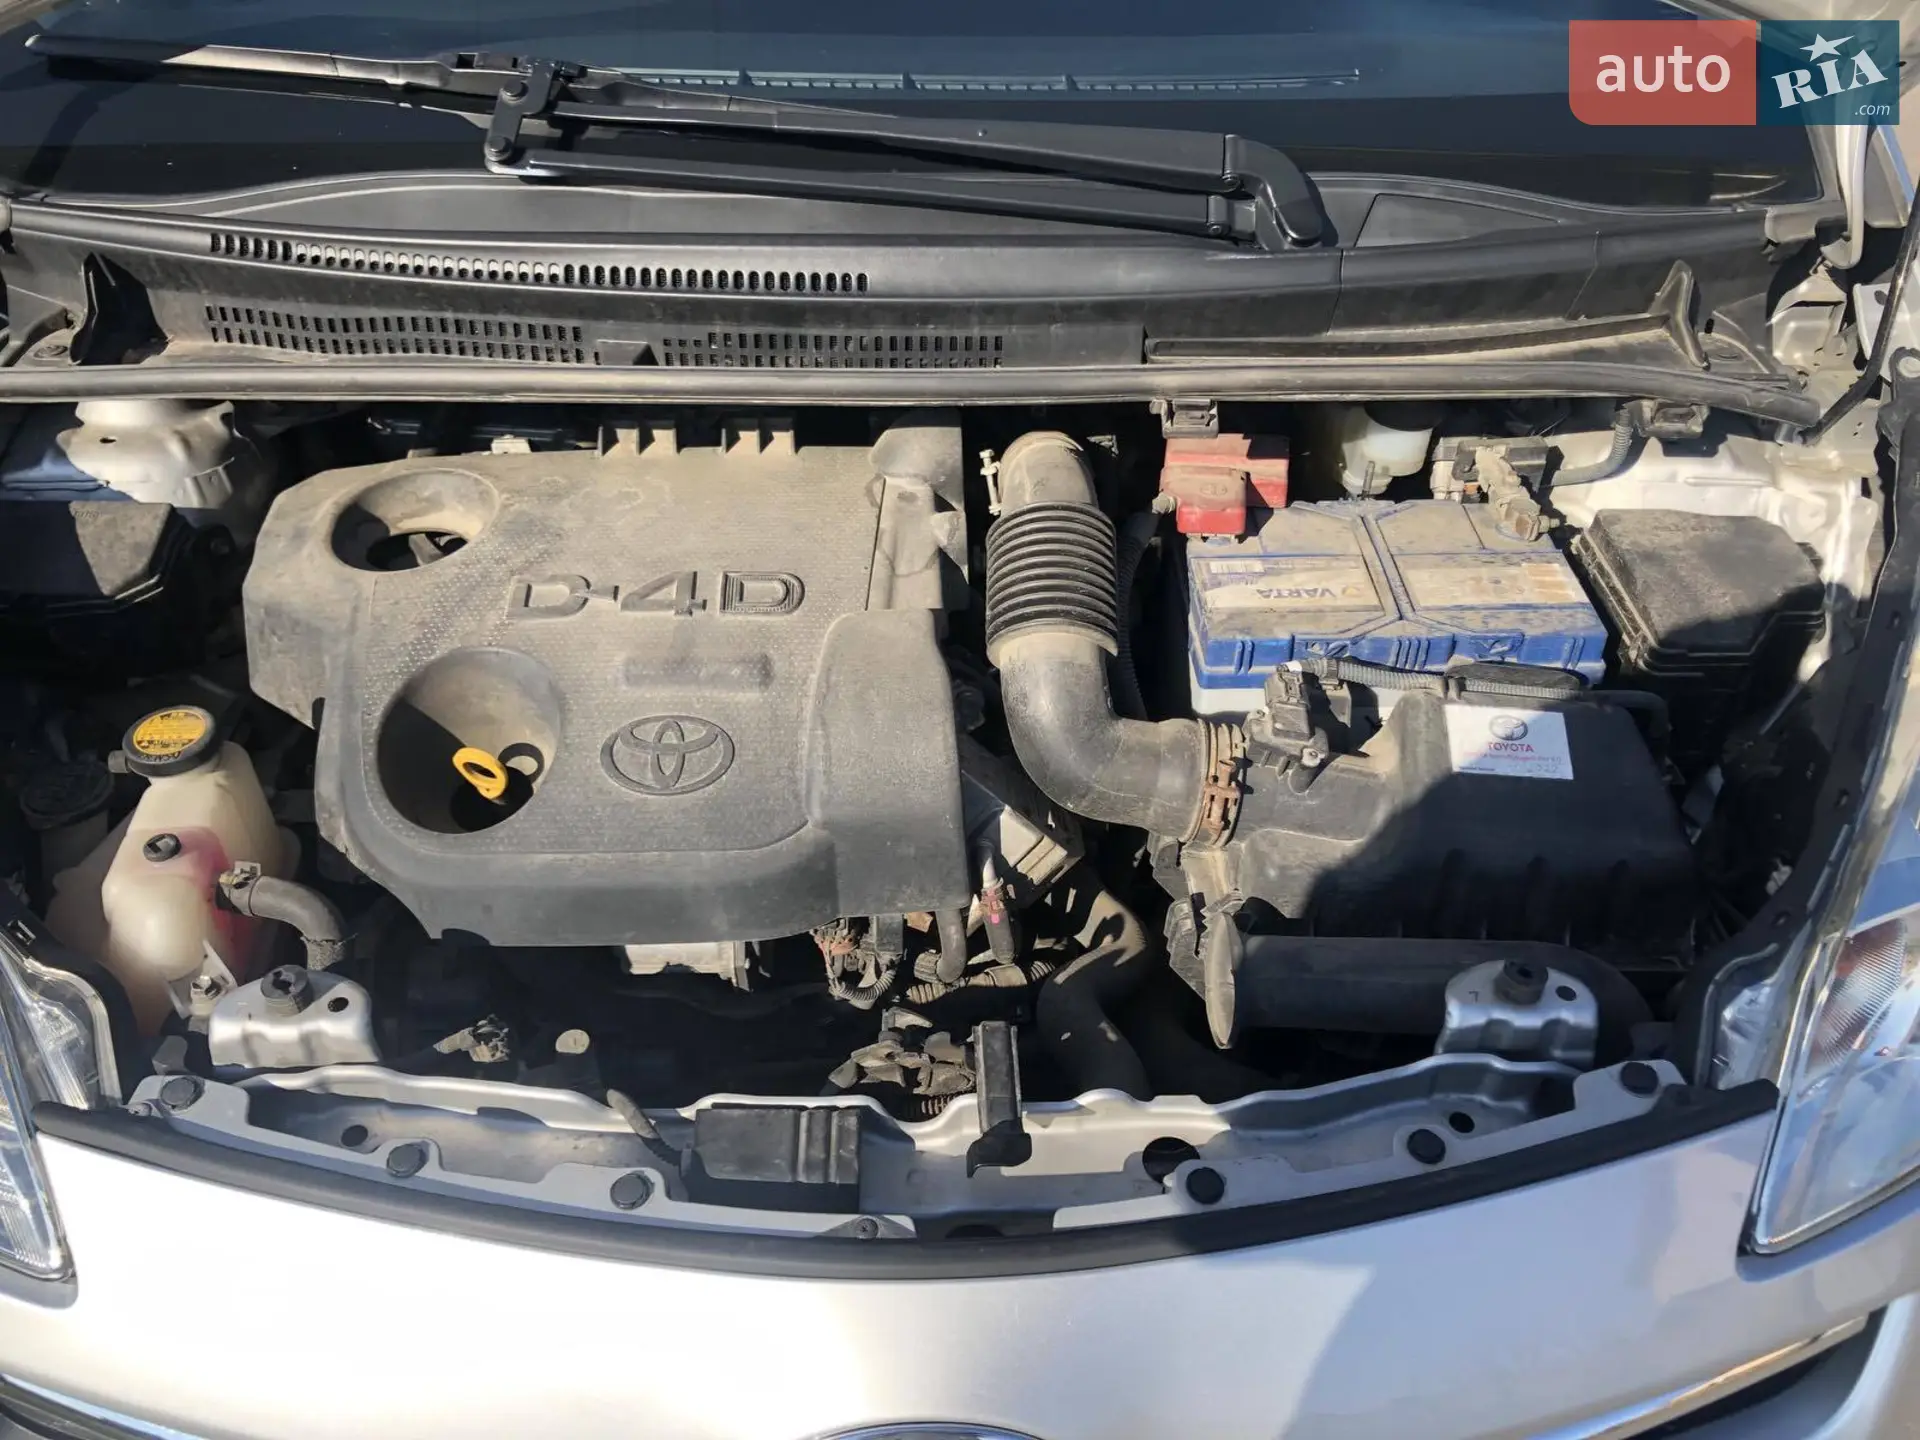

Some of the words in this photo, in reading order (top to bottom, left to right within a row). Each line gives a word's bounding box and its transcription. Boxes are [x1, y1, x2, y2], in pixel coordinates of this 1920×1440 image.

[504, 570, 806, 620] D-4D
[1256, 587, 1337, 600] VARTA
[1487, 742, 1535, 753] TOYOTA
